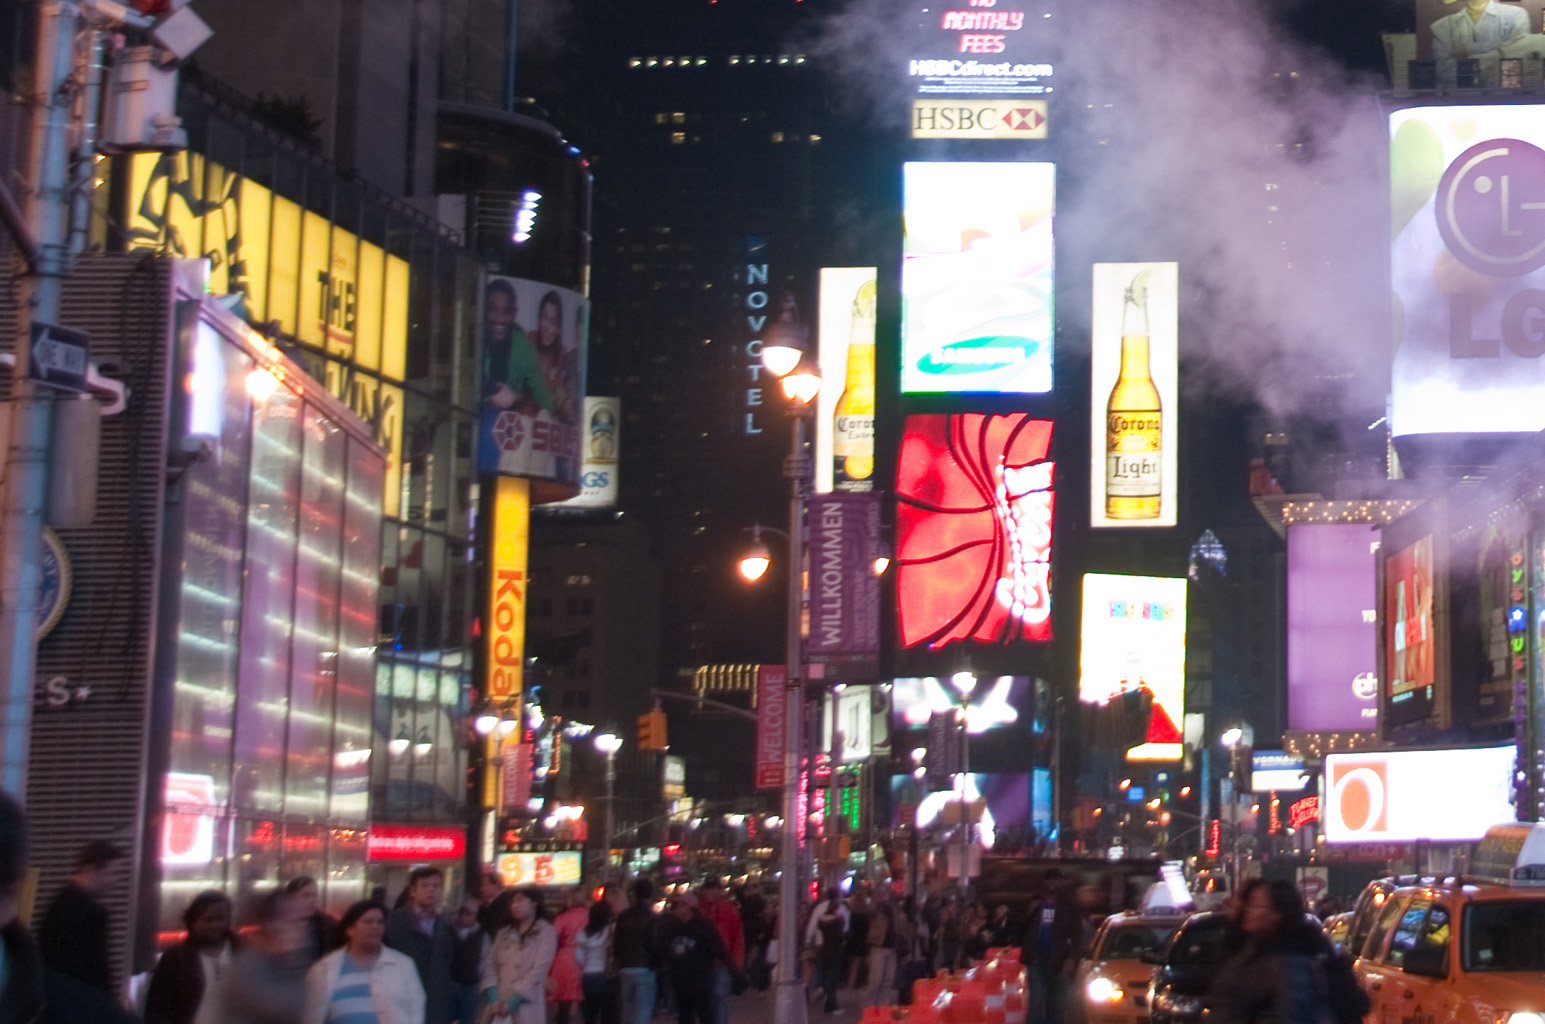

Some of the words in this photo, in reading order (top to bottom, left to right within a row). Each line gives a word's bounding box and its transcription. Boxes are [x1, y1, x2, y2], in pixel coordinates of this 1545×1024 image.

[943, 11, 1024, 31] MONTHLY
[959, 34, 1006, 53] FEES
[910, 60, 1053, 77] HSBCdirect.com
[914, 107, 998, 130] HSBC
[318, 270, 354, 331] THE
[1108, 416, 1160, 433] Corona
[1113, 456, 1157, 479] Light
[822, 502, 843, 646] WILLKOMMEN
[492, 569, 523, 698] Koda
[764, 673, 783, 760] WELCOME
